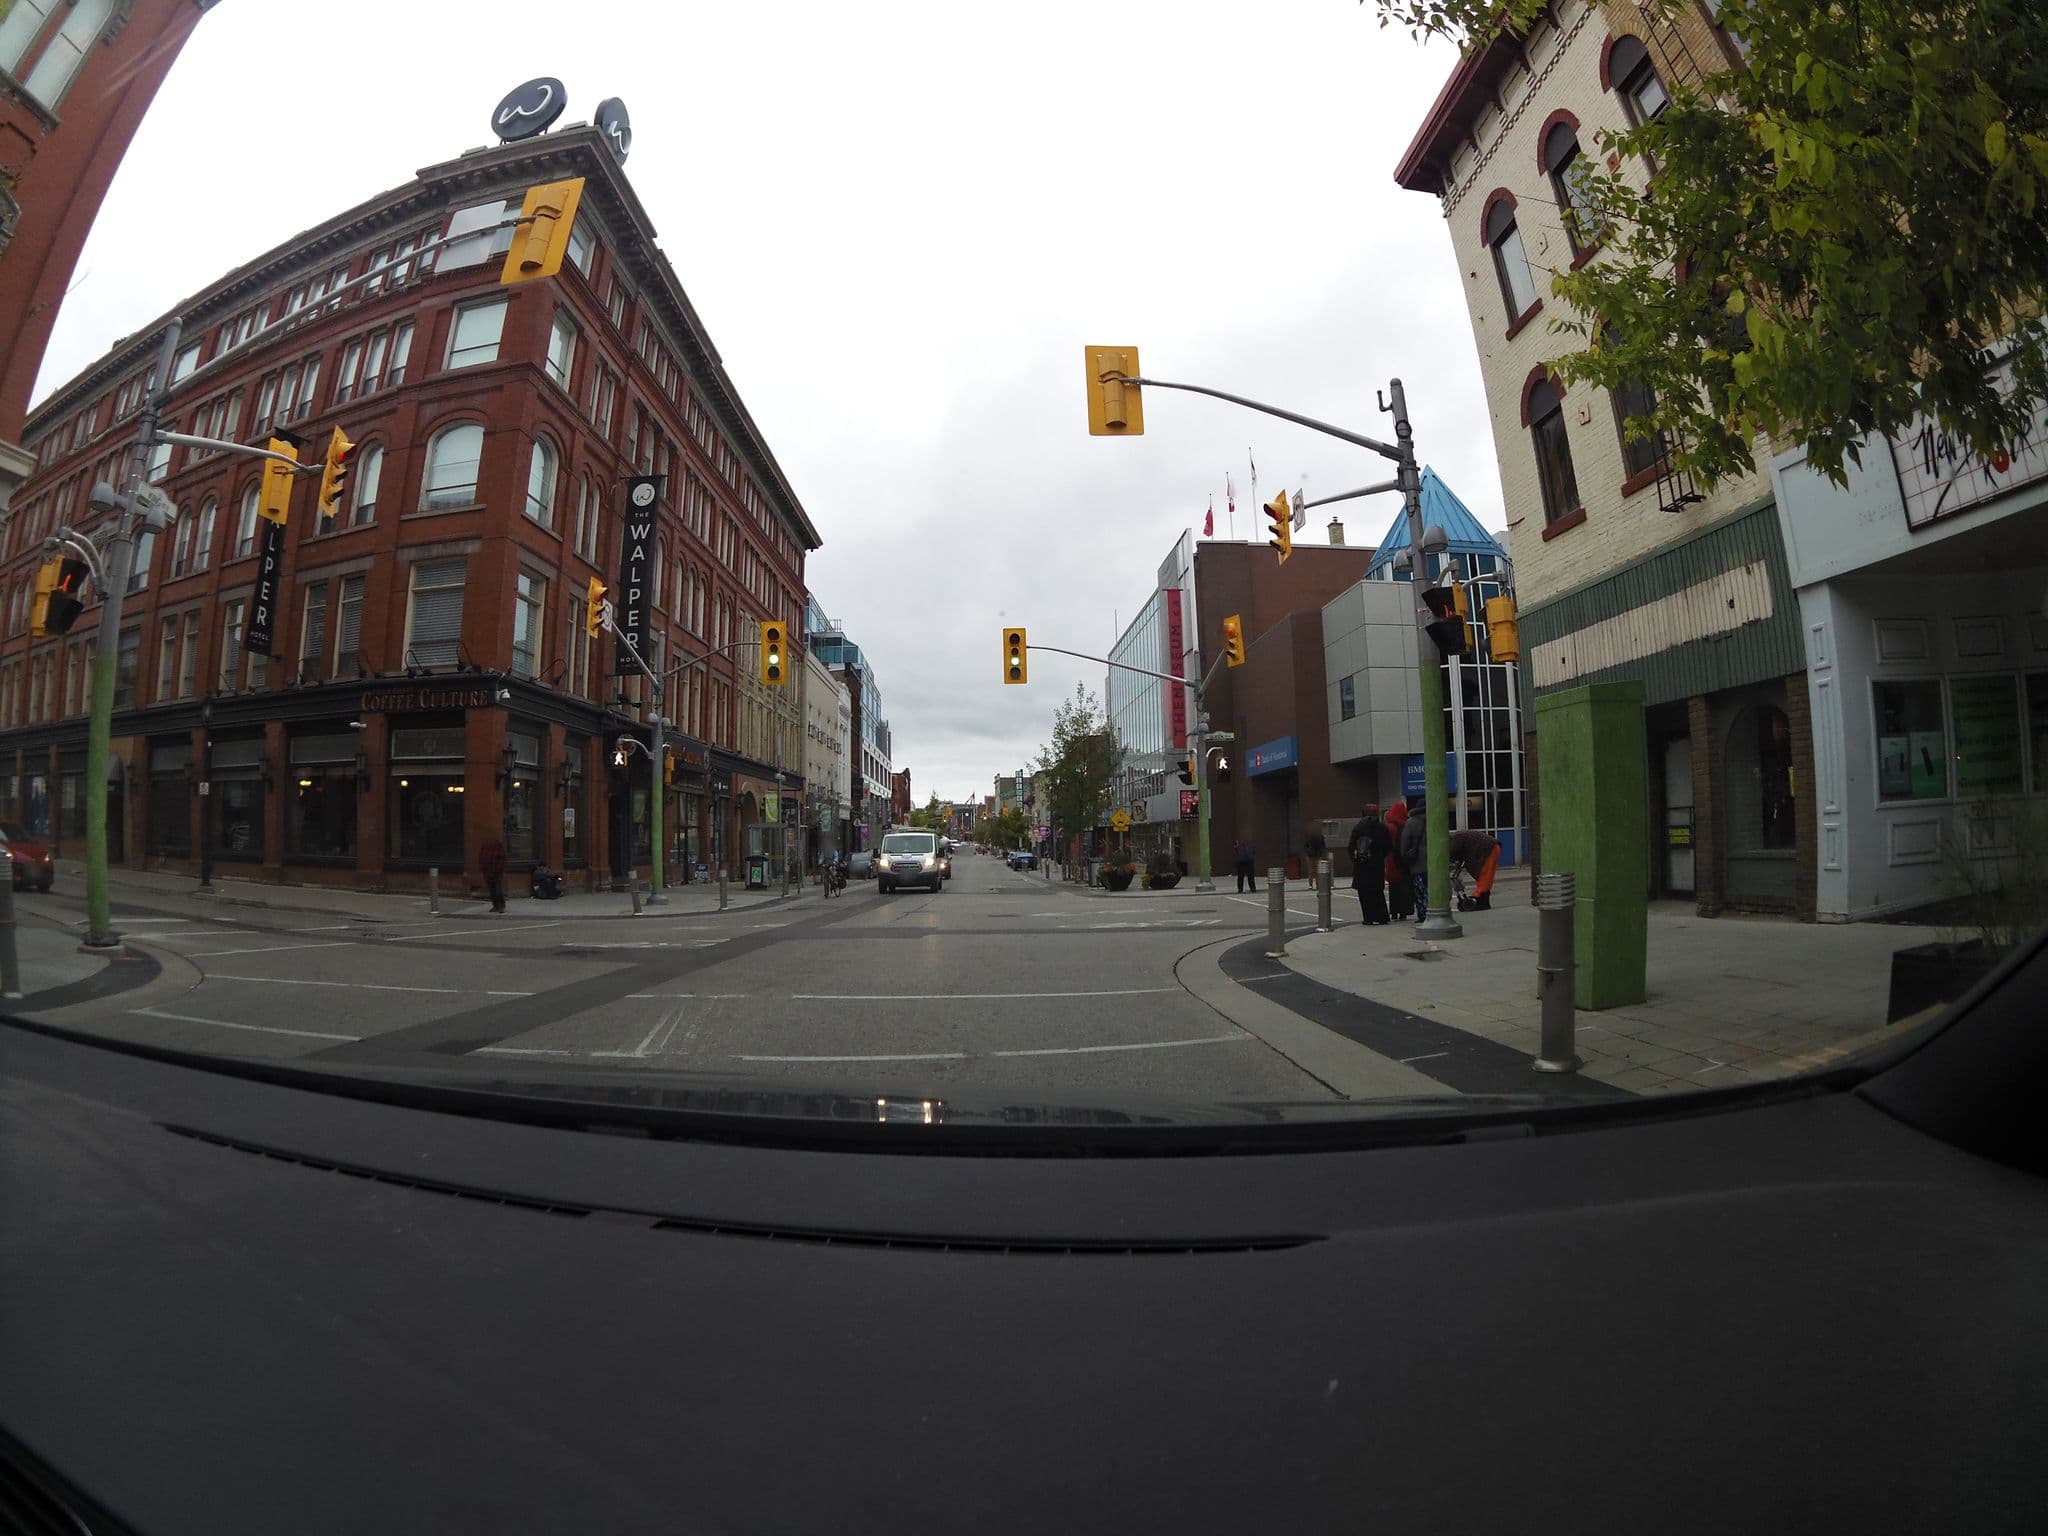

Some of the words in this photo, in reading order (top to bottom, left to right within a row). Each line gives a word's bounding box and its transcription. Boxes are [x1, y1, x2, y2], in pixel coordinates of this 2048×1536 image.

[626, 523, 651, 650] WALPER
[361, 690, 415, 711] COFFEE
[419, 688, 489, 709] CULTURE
